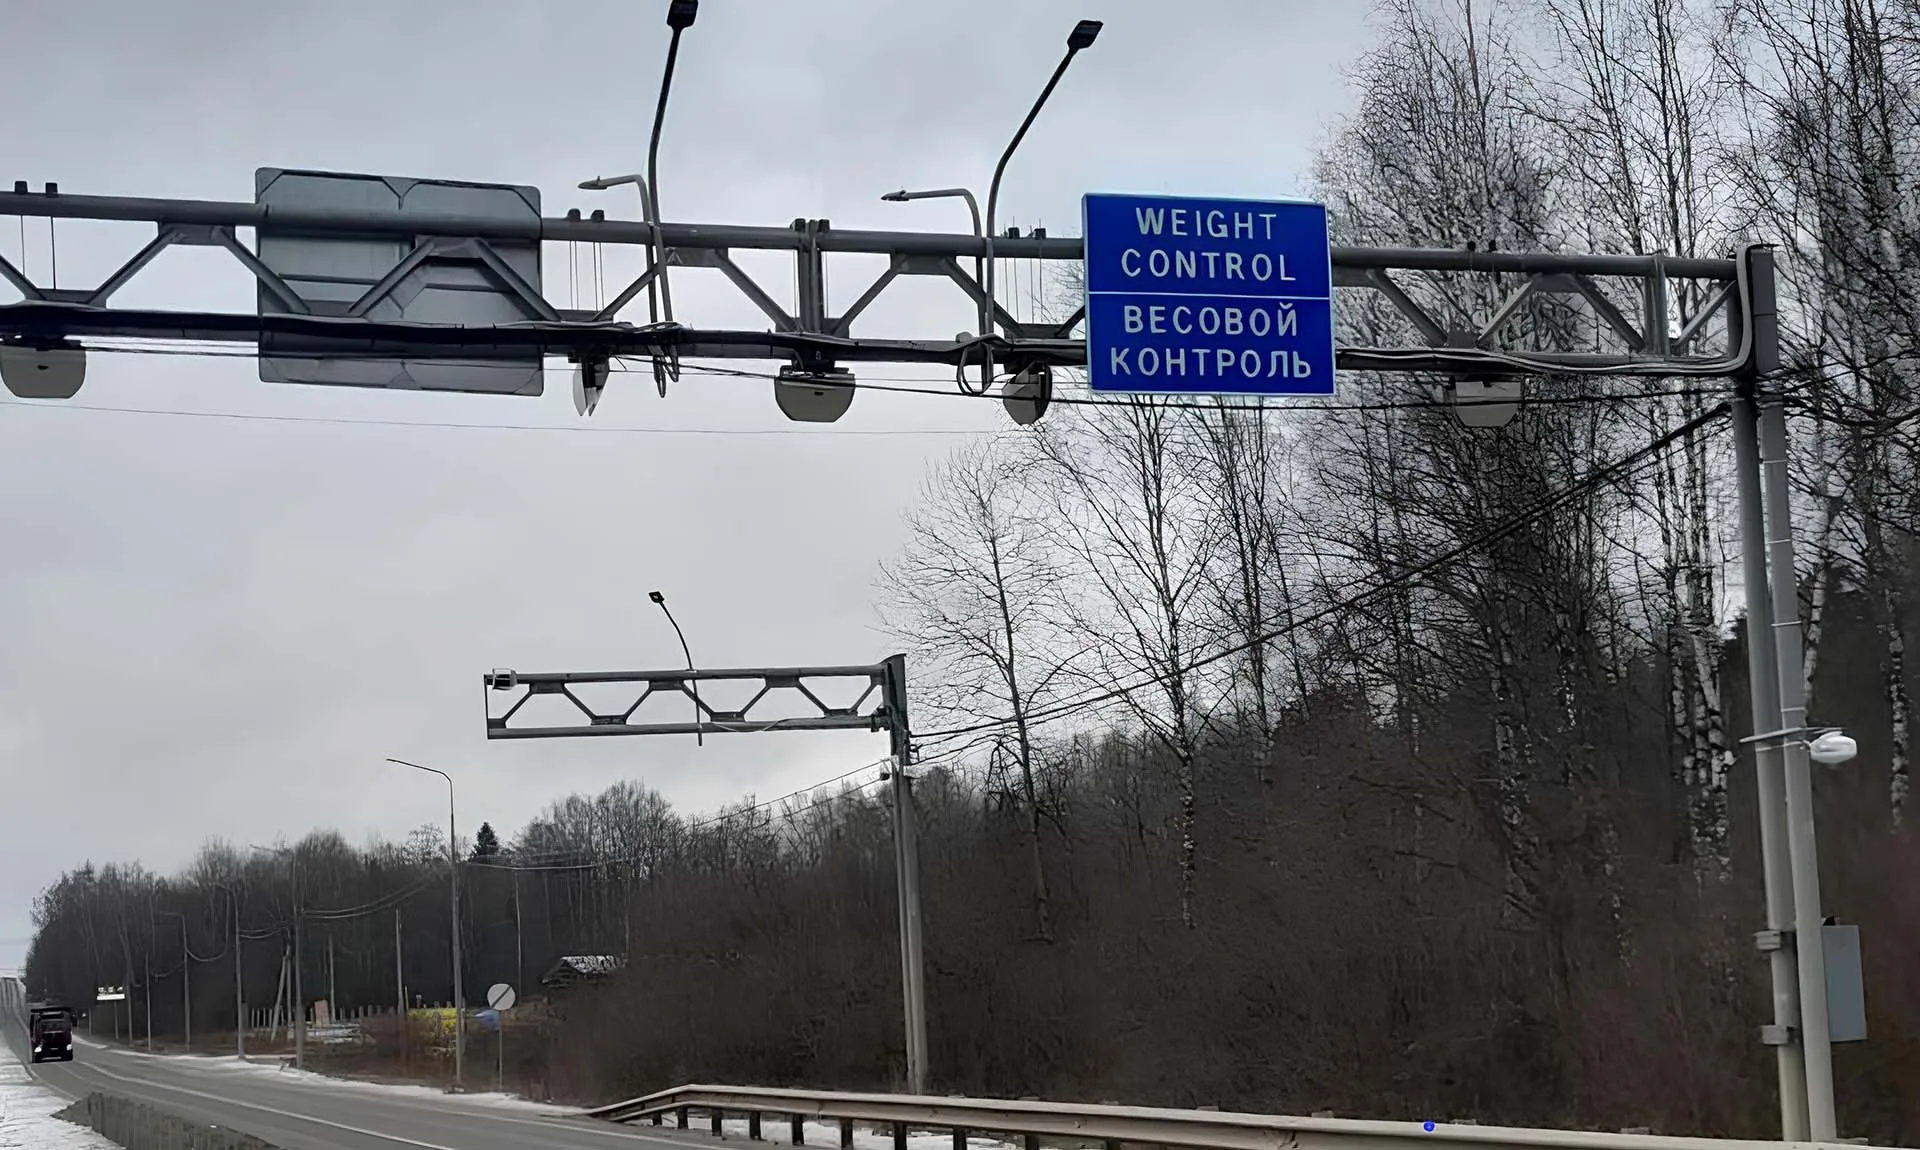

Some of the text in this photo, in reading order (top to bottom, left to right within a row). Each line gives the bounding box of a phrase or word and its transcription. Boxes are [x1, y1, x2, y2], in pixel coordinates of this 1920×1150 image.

[1136, 207, 1277, 240] WEIGHT
[1121, 248, 1296, 281] CONTROL
[1123, 302, 1297, 337] ВЕСОВОЙ
[1110, 347, 1312, 378] КОНТРОЛЬ
